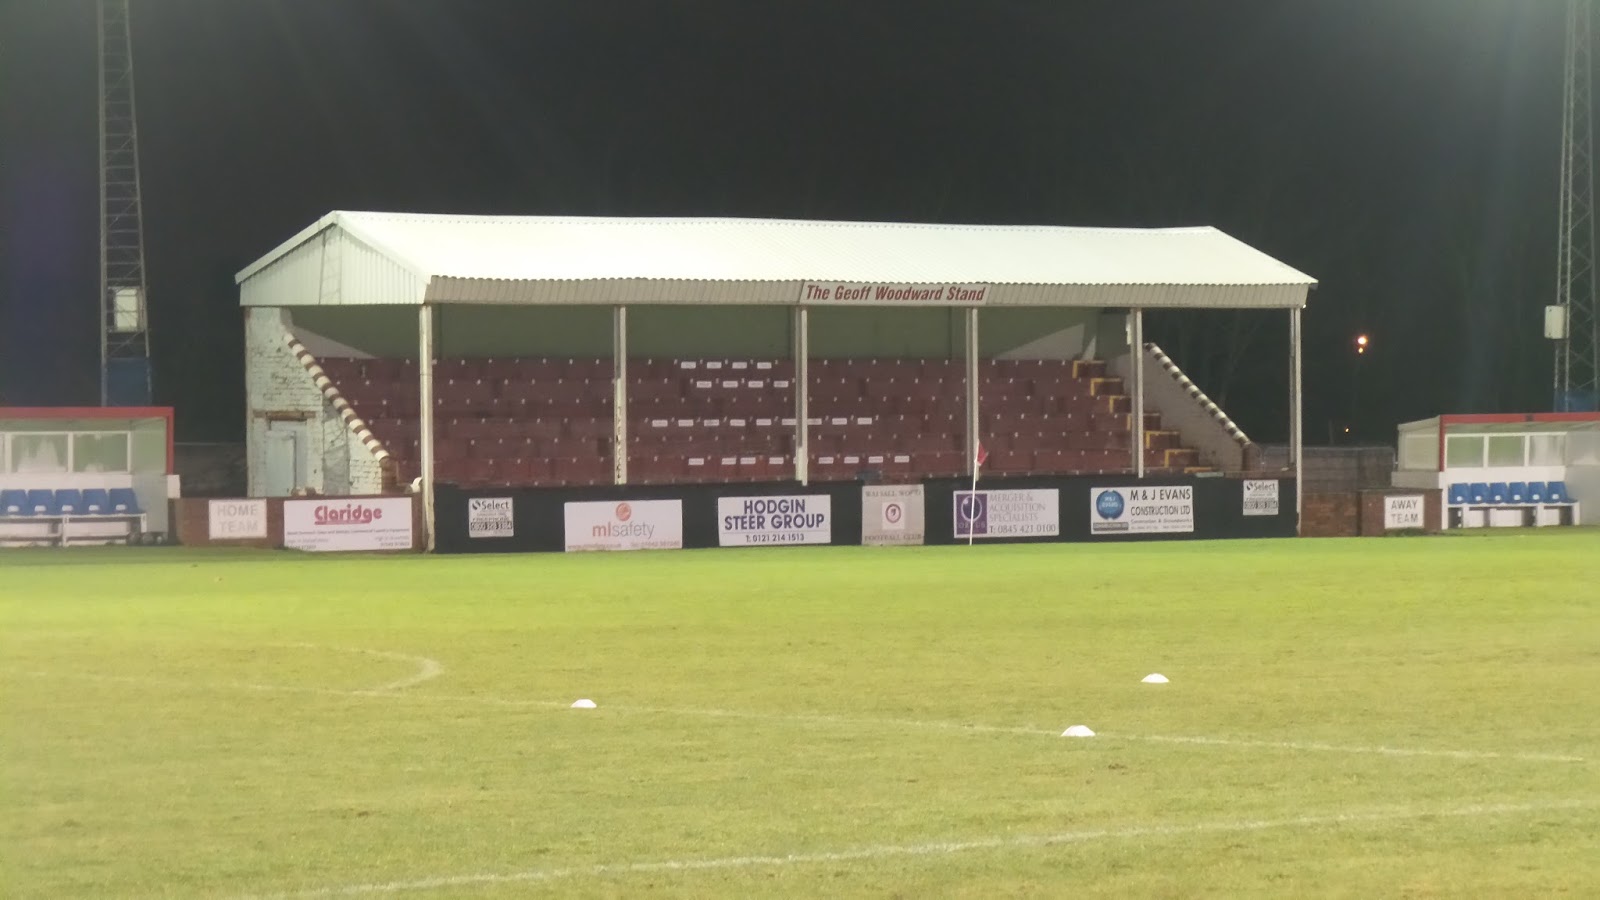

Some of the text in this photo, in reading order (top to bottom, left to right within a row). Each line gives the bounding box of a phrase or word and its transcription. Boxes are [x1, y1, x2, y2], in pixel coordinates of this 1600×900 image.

[806, 284, 987, 301] The Geoff Woodward Stand
[1253, 482, 1275, 491] Select
[989, 493, 1033, 502] MERGER &
[1129, 489, 1191, 501] M & J EVANS
[217, 504, 258, 517] HOME
[481, 500, 510, 510] Select
[743, 498, 806, 515] HODGIN
[989, 502, 1046, 512] ACQUISITION
[1130, 505, 1191, 516] CONSTRUCTION LTD
[1391, 500, 1418, 510] AWAY
[314, 503, 382, 525] Claridge
[989, 512, 1038, 522] SPECIALISTS
[1391, 513, 1419, 524] TEAM
[219, 519, 258, 533] TEAM
[724, 513, 825, 531] STEER GROUP
[592, 521, 655, 539] mlsafety
[989, 526, 996, 534] T:
[997, 525, 1018, 534] 0845
[1020, 524, 1034, 533] 421
[1036, 523, 1056, 532] 0100
[745, 533, 805, 543] T: 0121 214 1513
